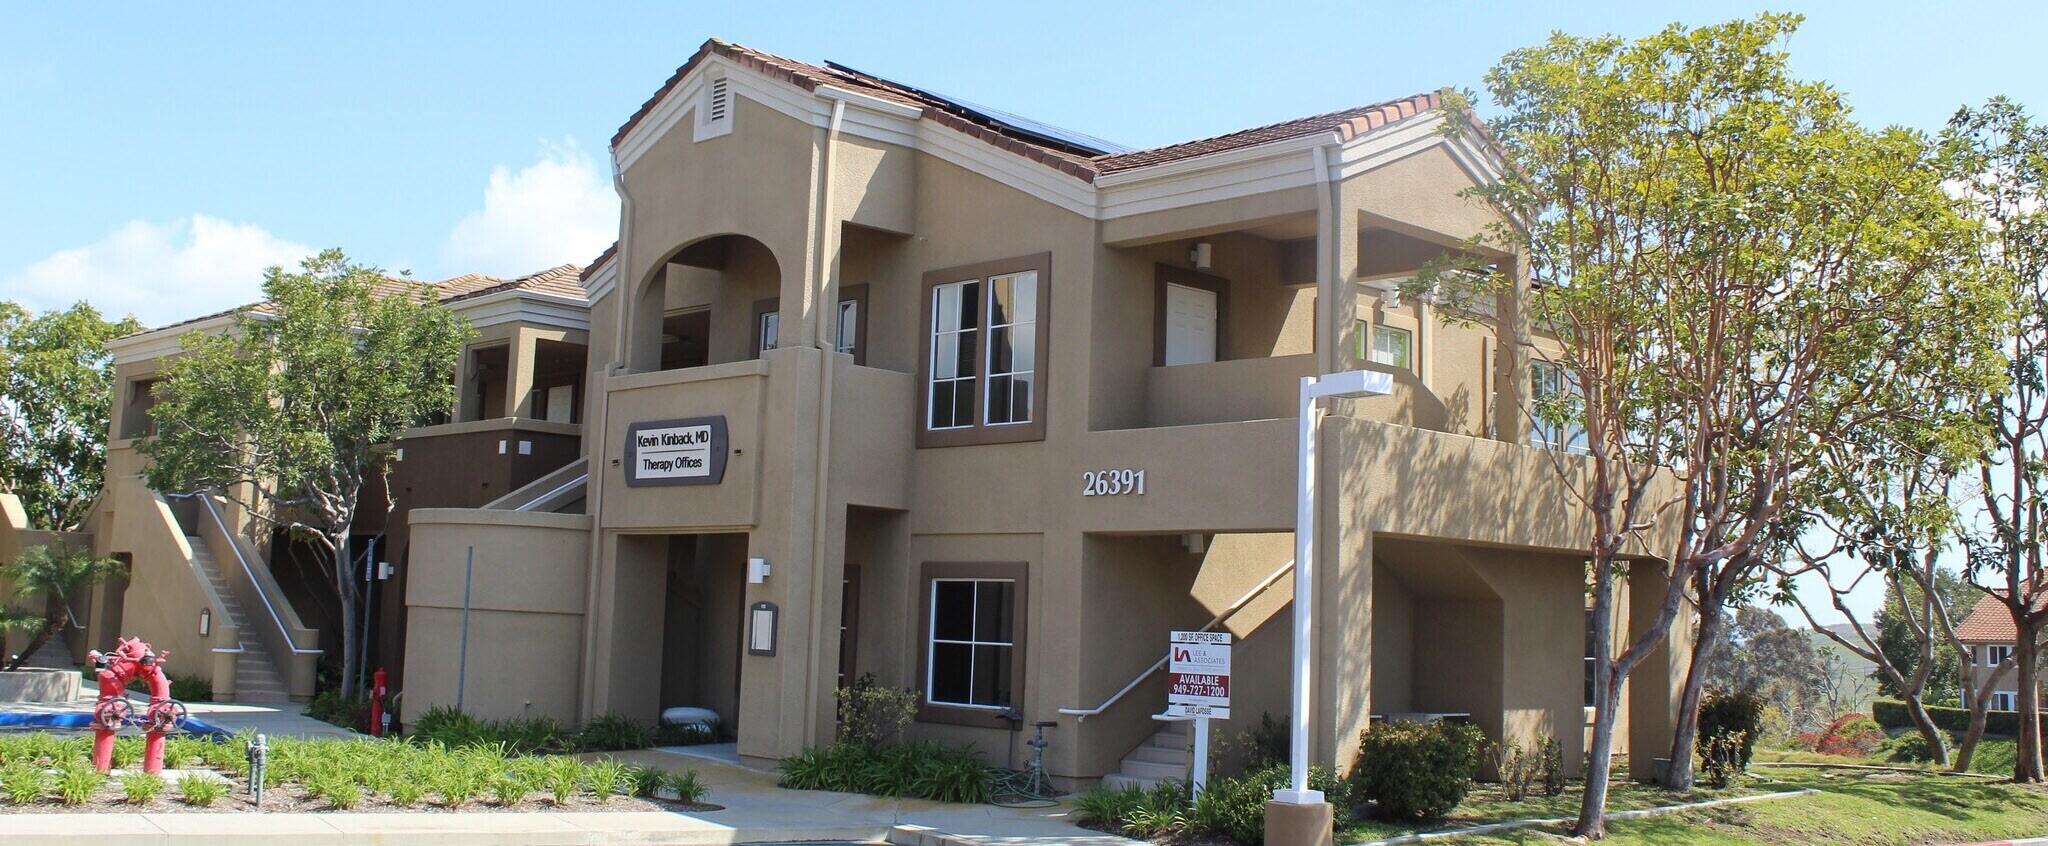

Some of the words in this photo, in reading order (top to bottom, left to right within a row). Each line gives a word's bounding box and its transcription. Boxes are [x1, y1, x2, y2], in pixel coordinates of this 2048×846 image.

[638, 434, 659, 447] Kevin
[661, 432, 694, 446] Kinback,
[695, 430, 709, 444] MD
[643, 458, 674, 472] Therapy
[675, 456, 702, 469] Offices
[1083, 469, 1144, 496] 26391
[1195, 633, 1209, 642] OFFICE
[1209, 633, 1223, 643] SPACE
[1179, 674, 1219, 686] AVAILABLE
[1173, 684, 1225, 697] 949-727-1200
